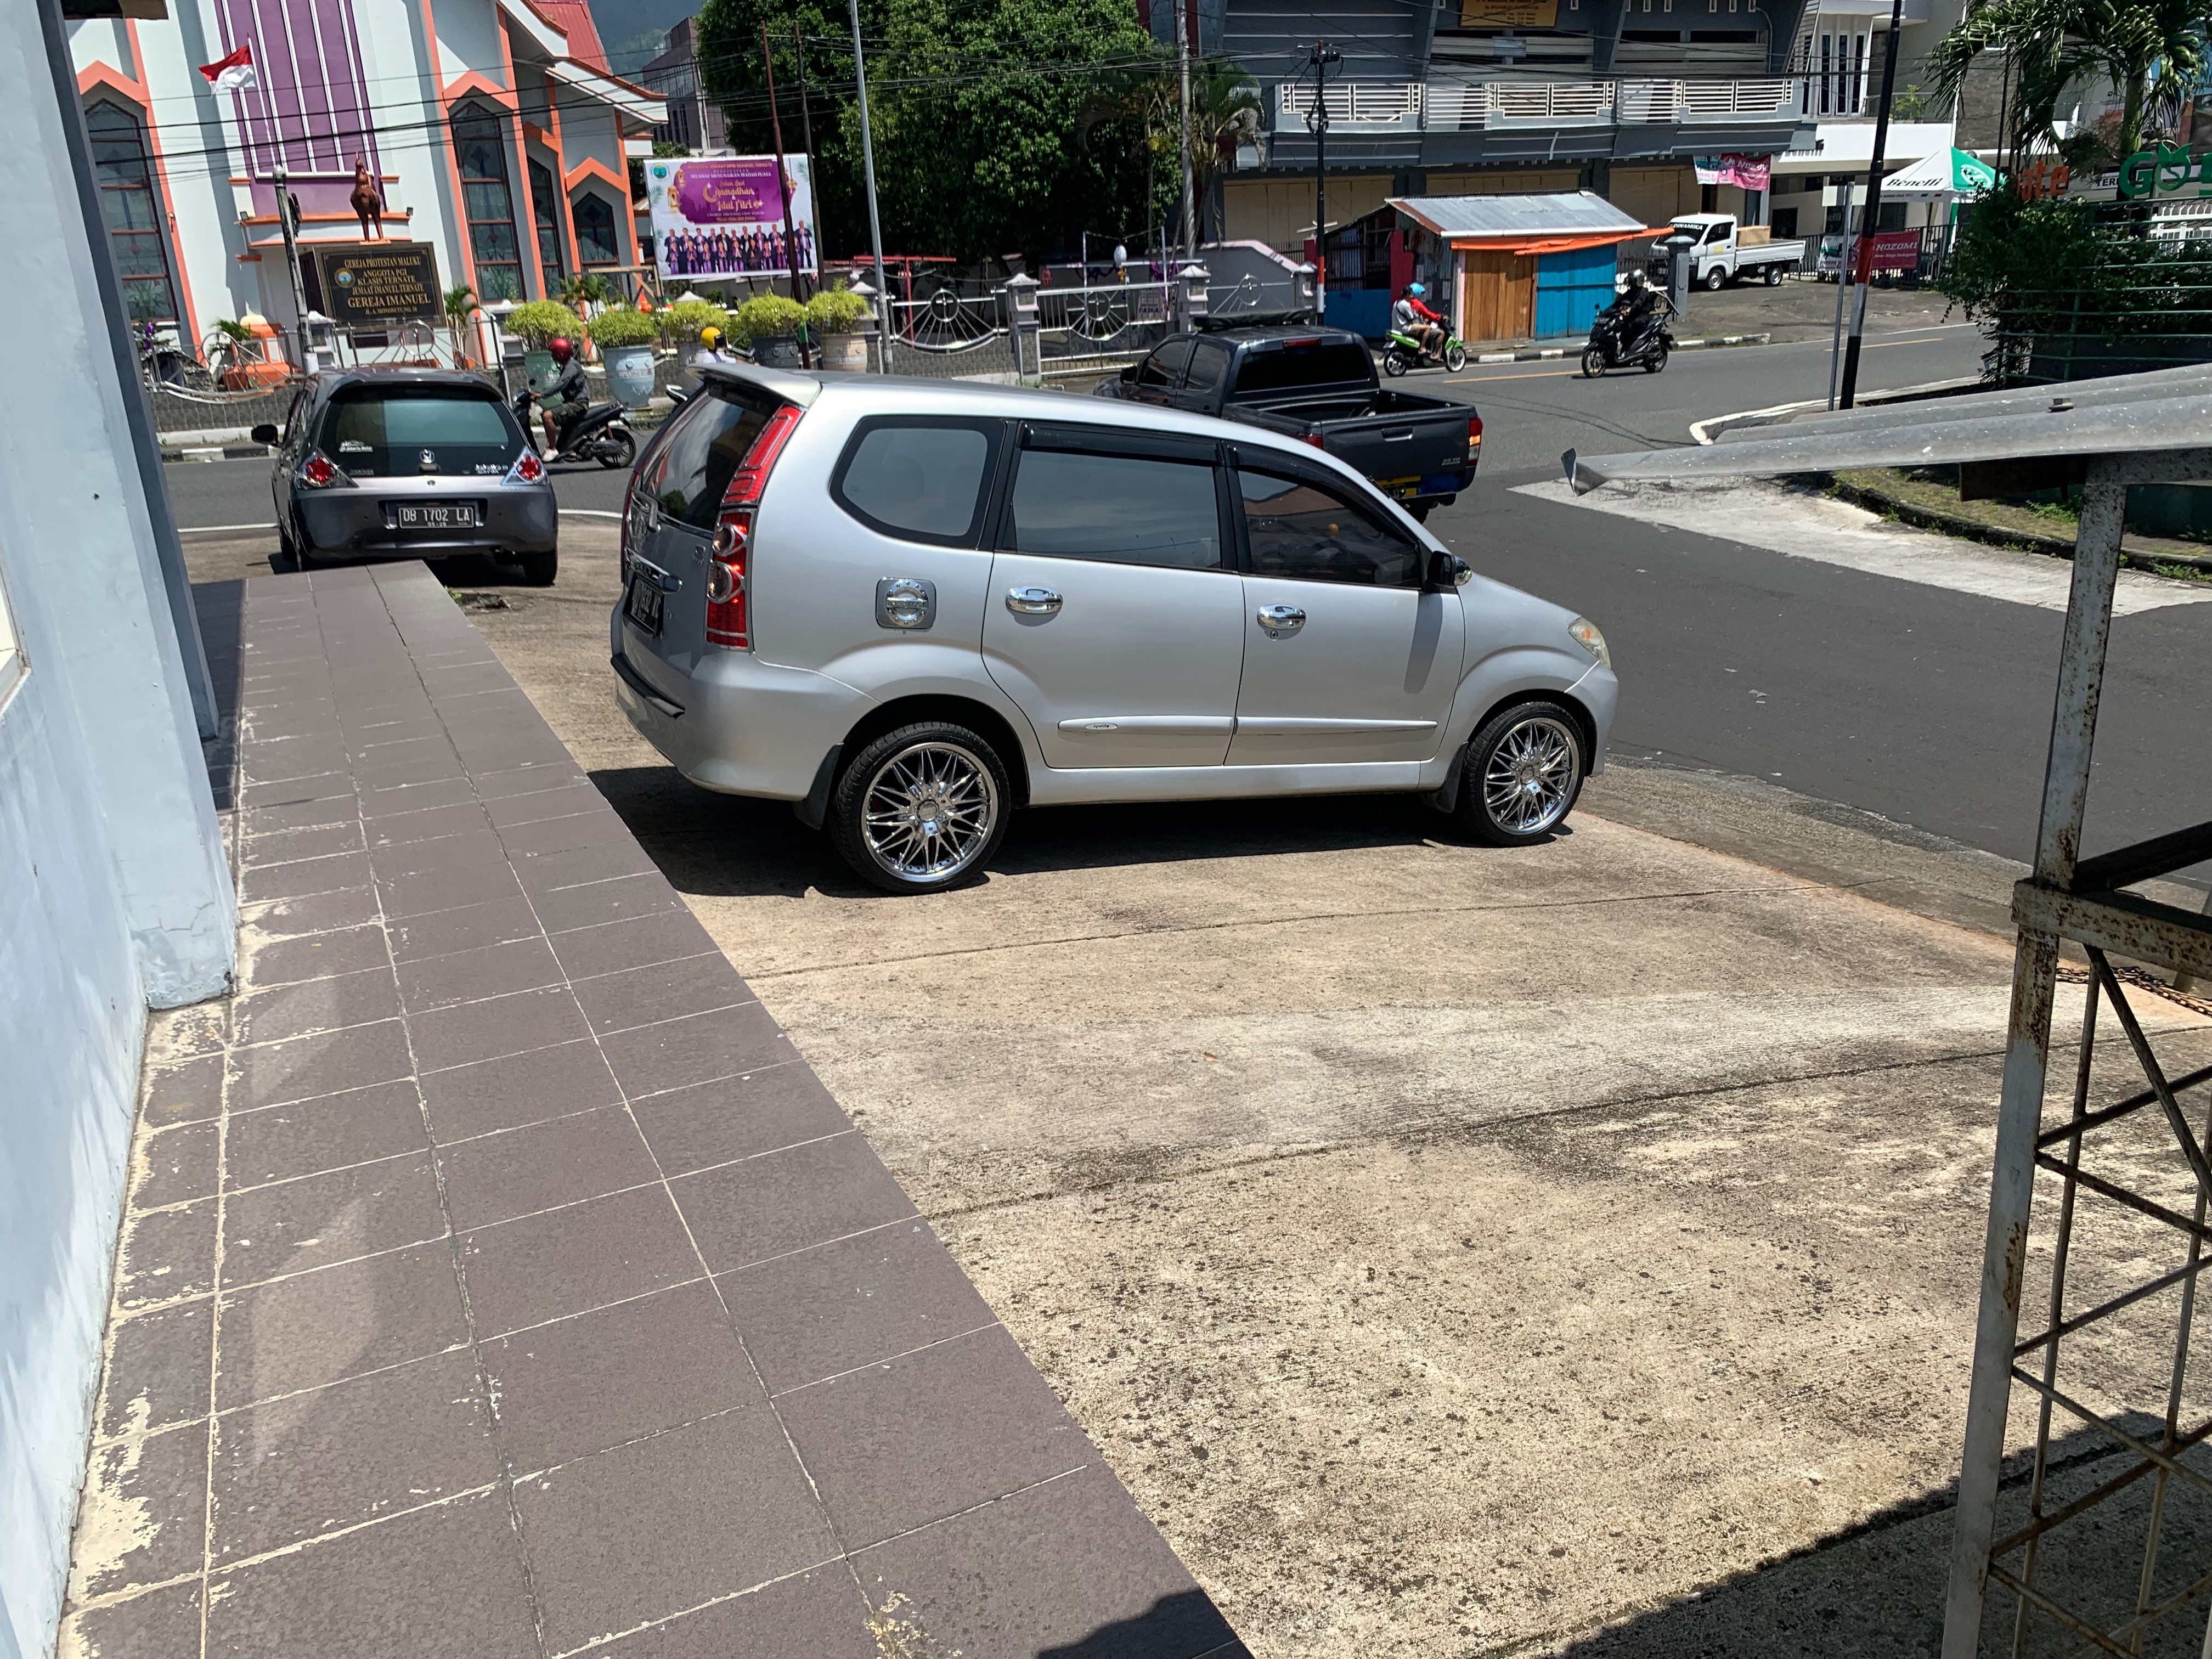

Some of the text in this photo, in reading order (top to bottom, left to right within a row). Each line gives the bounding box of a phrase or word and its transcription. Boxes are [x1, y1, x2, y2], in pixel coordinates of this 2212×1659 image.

[1886, 178, 1943, 187] Benelli
[1876, 242, 1917, 251] NOZOMI
[345, 256, 421, 268] GEREJA PROTESTAN MALUKU
[363, 269, 394, 278] ANGGOTA
[358, 275, 416, 286] KLASIS TERNATE
[352, 283, 424, 296] JEMAAT IMANUEL TERNATE
[348, 293, 431, 308] GEREJA IMANUEL
[403, 508, 470, 521] DB 1702 LA
